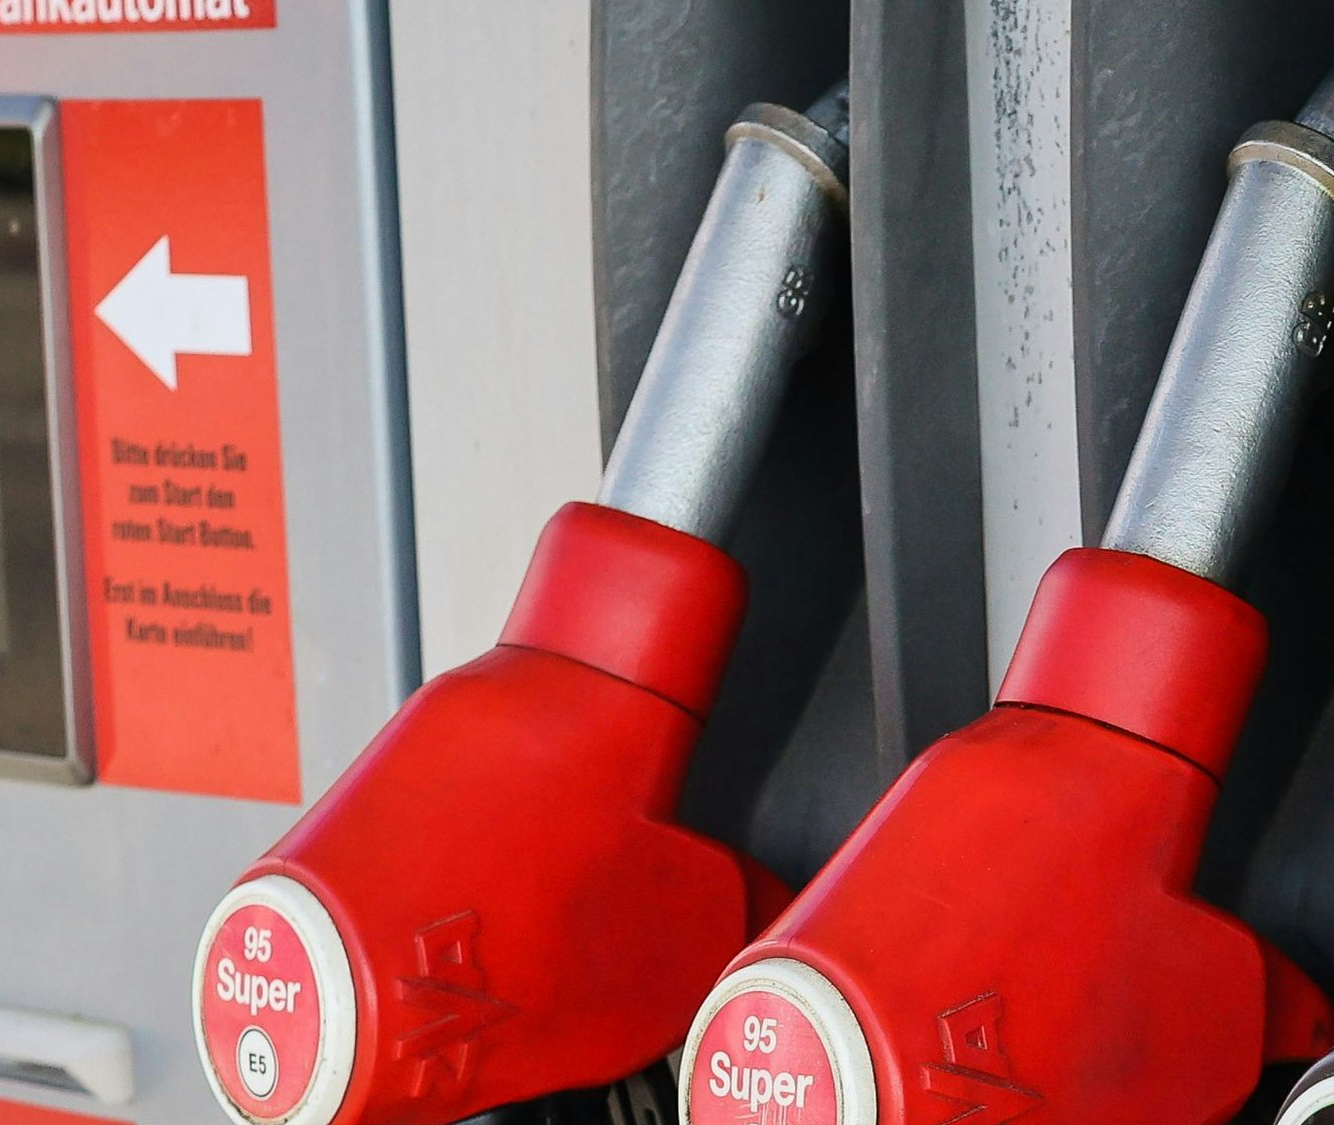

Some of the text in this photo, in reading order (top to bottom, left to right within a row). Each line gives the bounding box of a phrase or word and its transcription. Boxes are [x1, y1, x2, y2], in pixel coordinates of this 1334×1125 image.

[111, 438, 247, 471] Bitte drücken Sie
[129, 479, 235, 509] zum Start den
[112, 521, 152, 541] roten
[157, 517, 196, 545] Start
[103, 576, 272, 615] Erst im Anschluss die
[126, 618, 167, 644] Karte
[243, 926, 272, 963] 95
[217, 957, 301, 1016] Super
[743, 1015, 777, 1053] 95
[249, 1052, 267, 1075] E5
[708, 1050, 815, 1112] Super
